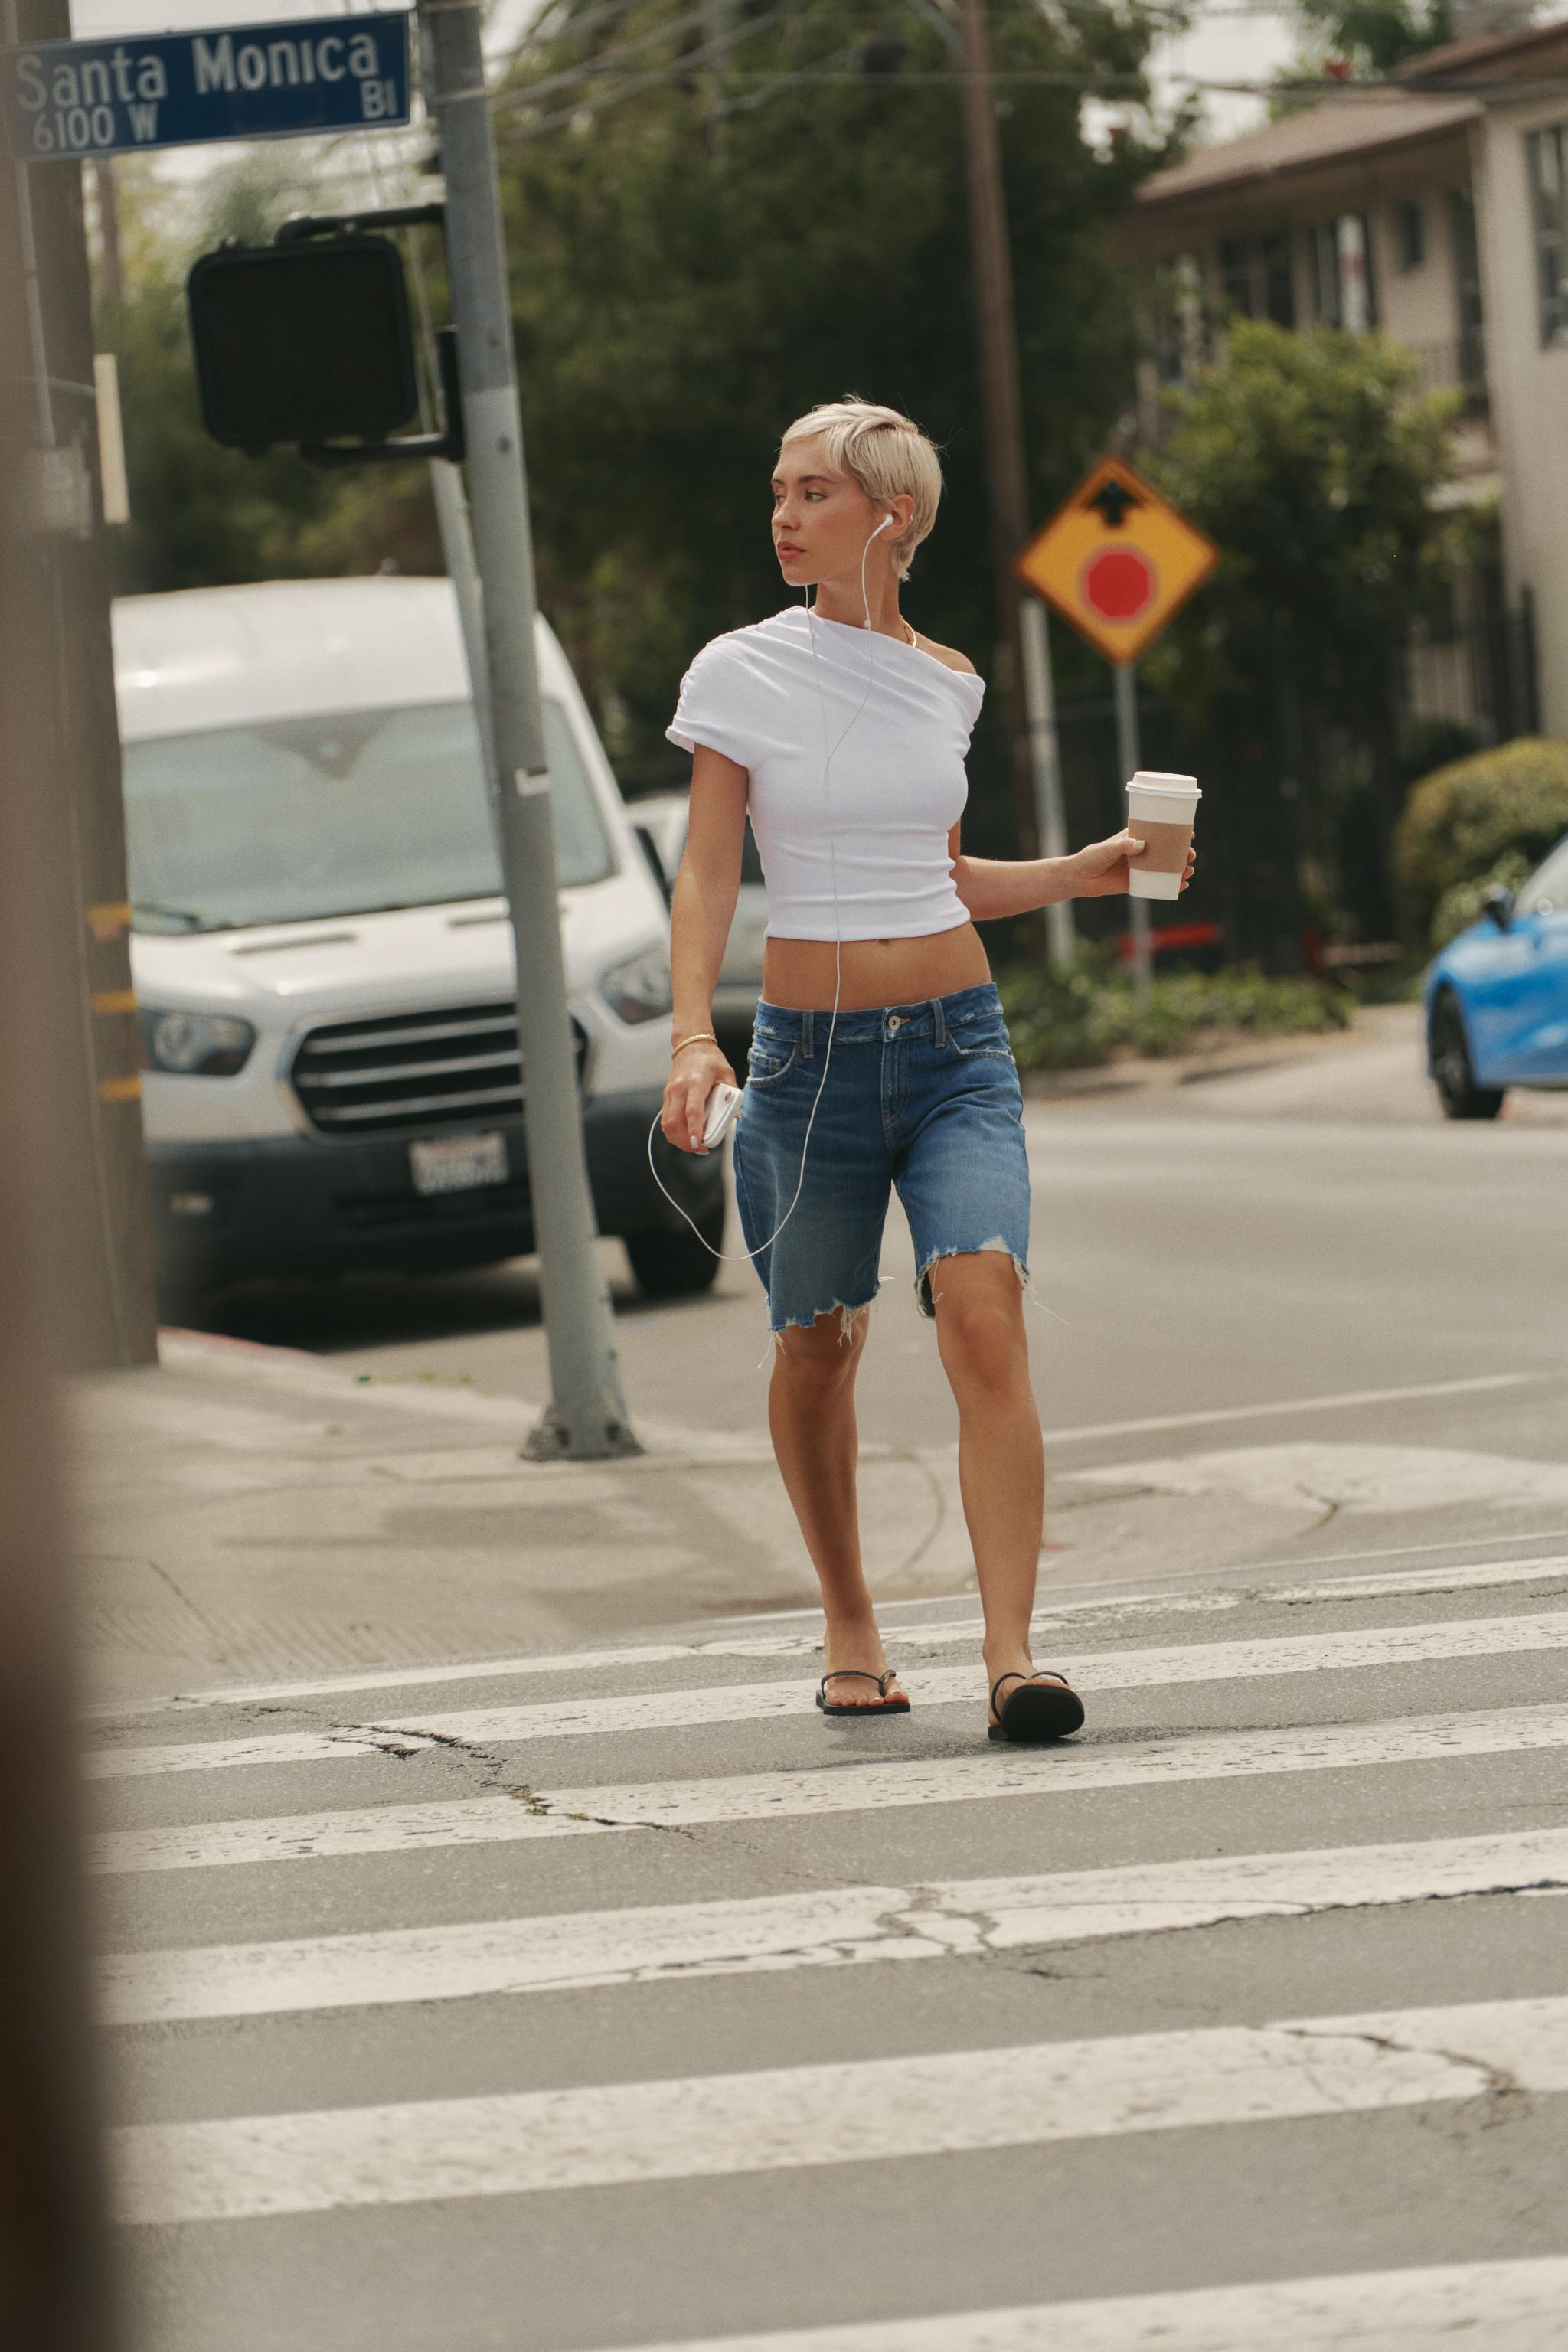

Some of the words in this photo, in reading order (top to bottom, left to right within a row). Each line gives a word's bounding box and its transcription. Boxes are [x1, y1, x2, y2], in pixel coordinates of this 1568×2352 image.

[15, 46, 168, 113] Santa
[191, 33, 381, 96] Monica
[33, 104, 116, 152] 6100
[127, 100, 158, 142] W
